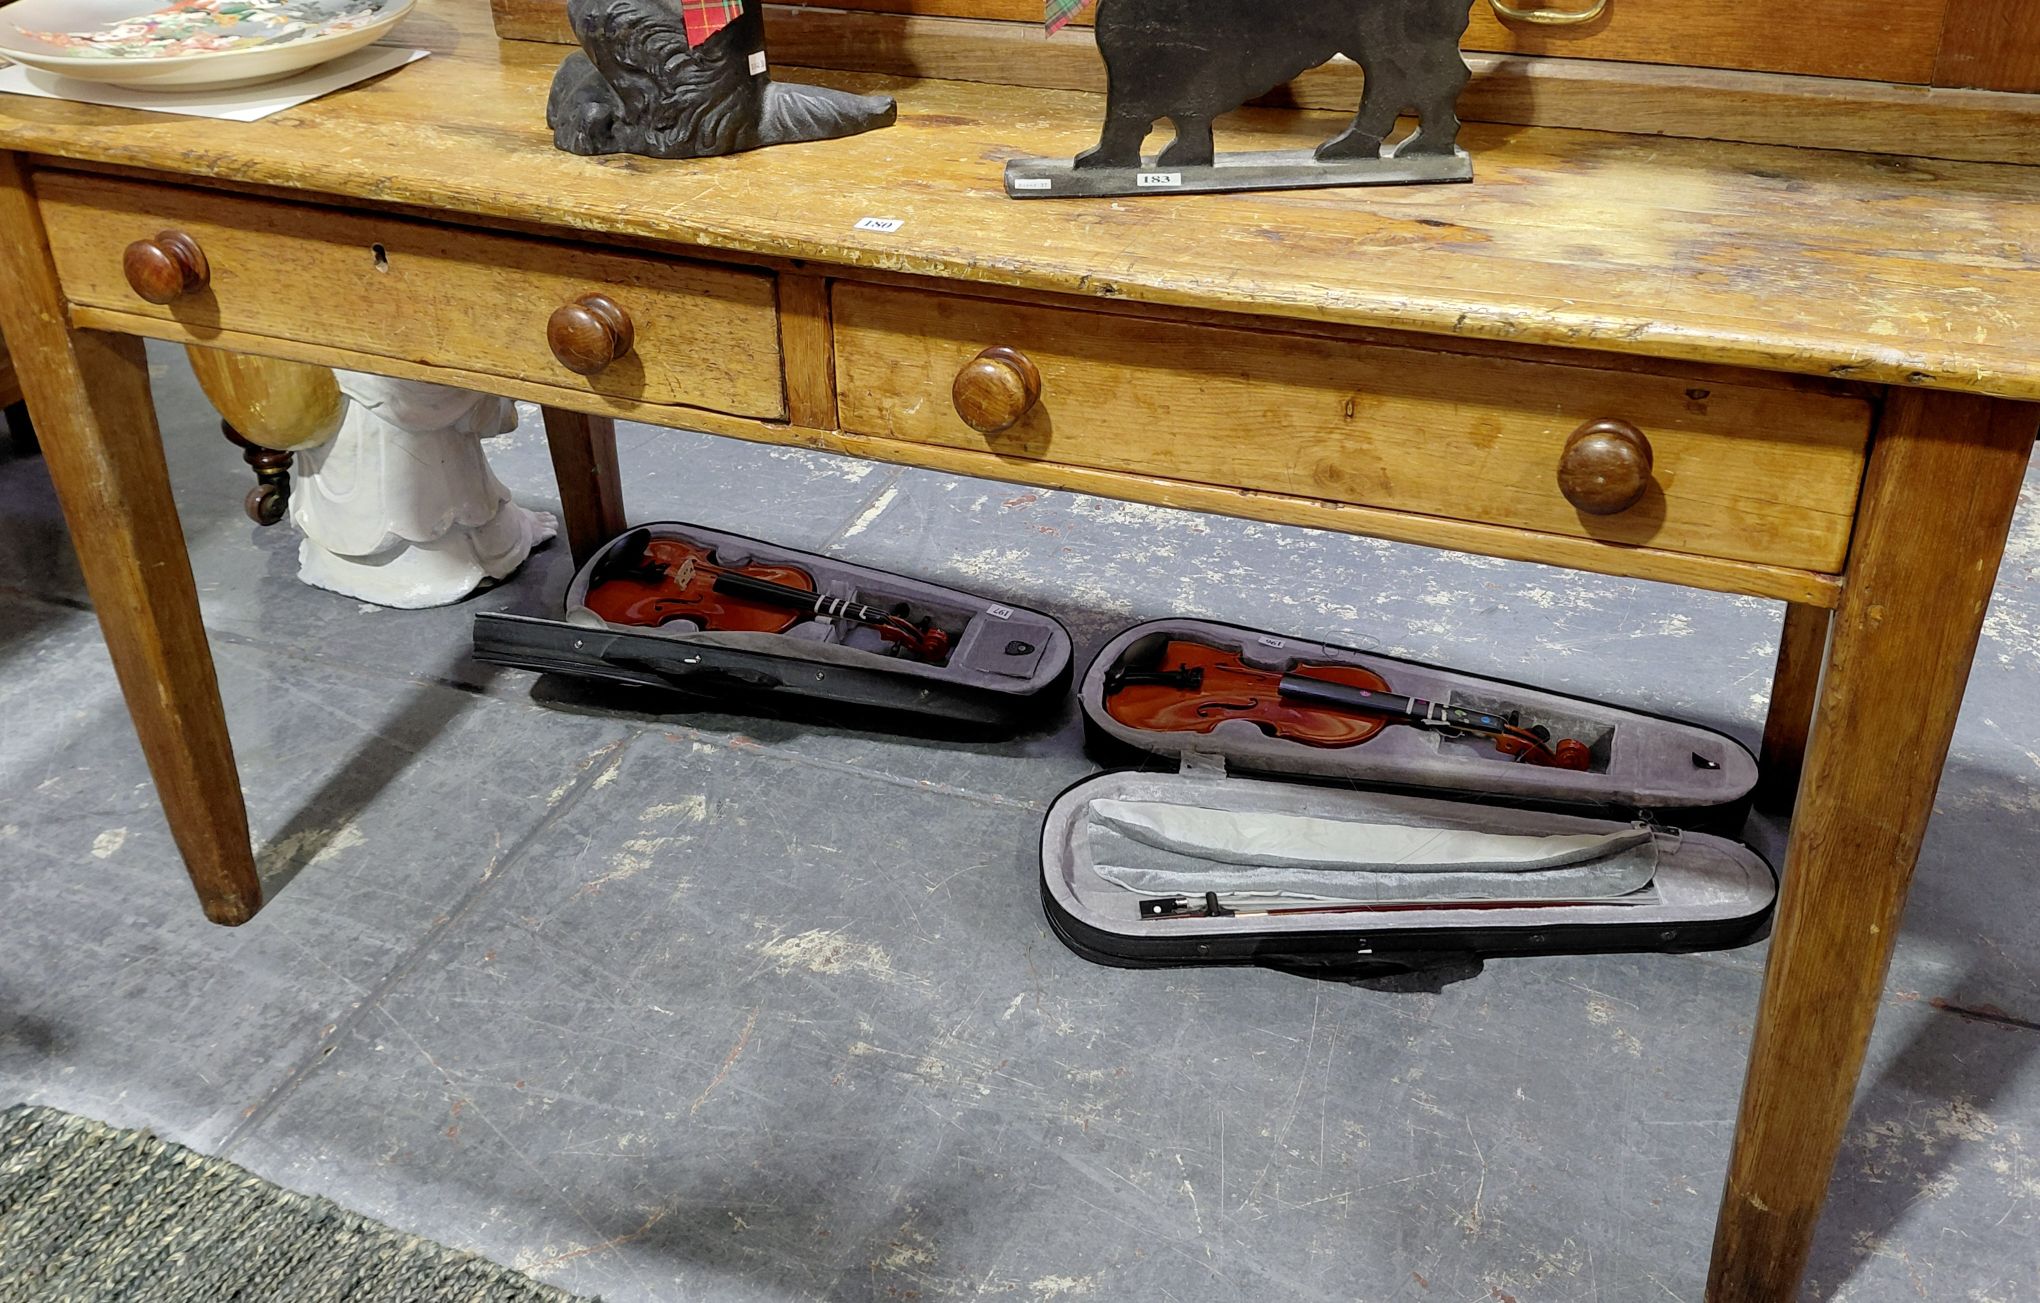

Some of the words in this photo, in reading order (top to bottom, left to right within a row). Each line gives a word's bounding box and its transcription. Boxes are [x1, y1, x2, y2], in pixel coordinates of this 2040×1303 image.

[1143, 175, 1171, 184] 183
[863, 219, 893, 229] 180
[992, 607, 1010, 617] 197
